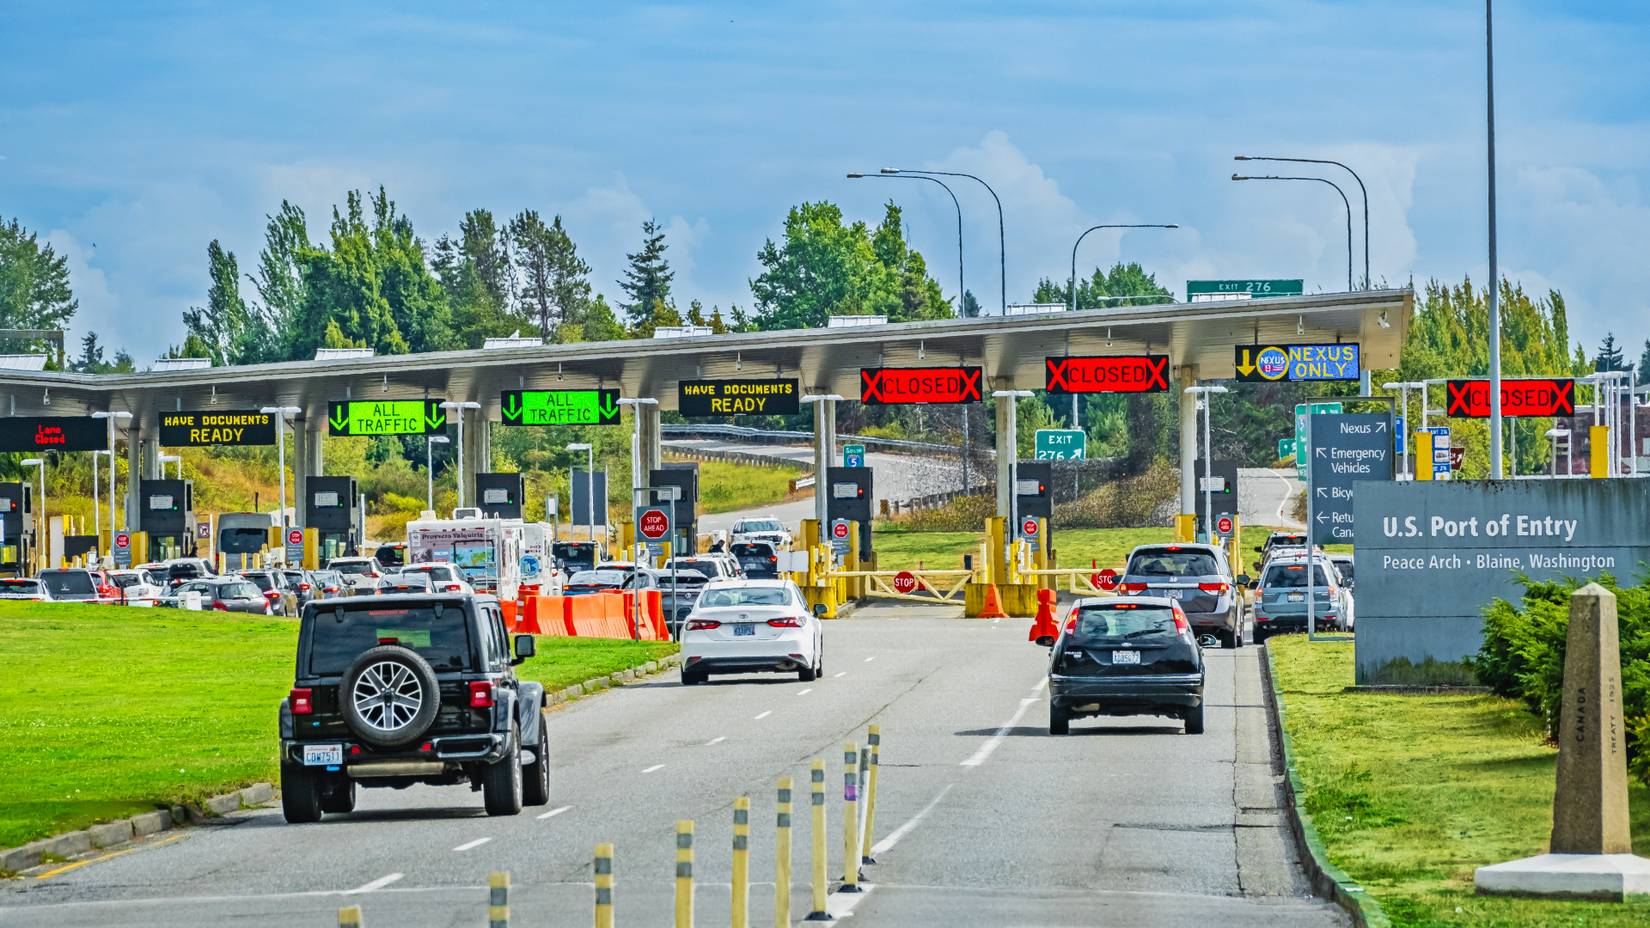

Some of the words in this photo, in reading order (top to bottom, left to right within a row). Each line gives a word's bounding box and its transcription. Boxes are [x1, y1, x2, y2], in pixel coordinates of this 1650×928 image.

[1218, 283, 1239, 291] EXIT
[1246, 282, 1271, 292] 276
[1260, 355, 1286, 365] NEXUS
[1289, 347, 1354, 361] NEXUS
[1068, 366, 1147, 384] CLOSED
[1295, 363, 1347, 378] ONLY
[684, 385, 716, 395] HAVE
[723, 383, 793, 395] DOCUMENTS
[883, 376, 959, 395] CLOSED
[547, 393, 574, 407] ALL
[1471, 389, 1550, 407] CLOSED
[373, 404, 400, 417] ALL
[711, 398, 766, 412] READY
[530, 408, 591, 421] TRAFFIC
[164, 416, 194, 427] HAVE
[202, 415, 269, 426] DOCUMENTS
[357, 418, 417, 432] TRAFFIC
[38, 424, 61, 434] Lane
[1340, 422, 1371, 434] Nexus
[34, 433, 65, 444] Closed
[190, 428, 244, 443] READY
[1048, 435, 1072, 444] EXIT
[1038, 450, 1065, 460] 276
[1331, 447, 1386, 461] Emergency
[851, 458, 857, 467] 5
[1331, 462, 1370, 474] Vehicles
[1332, 487, 1354, 501] Bicy
[646, 516, 662, 524] STOP
[1332, 512, 1354, 523] Retu
[643, 524, 665, 532] AHEAD
[1332, 526, 1354, 538] Can
[1383, 516, 1423, 537] U.S.
[1431, 516, 1478, 537] Port
[1485, 514, 1510, 536] of
[1516, 515, 1577, 542] Entry
[1383, 555, 1424, 569] Peace
[1429, 555, 1461, 569] Arch
[1476, 554, 1525, 570] Blaine,
[1529, 553, 1615, 572] Washington
[895, 578, 914, 587] STOP
[1099, 576, 1114, 584] STO
[1576, 687, 1586, 742] CANADA
